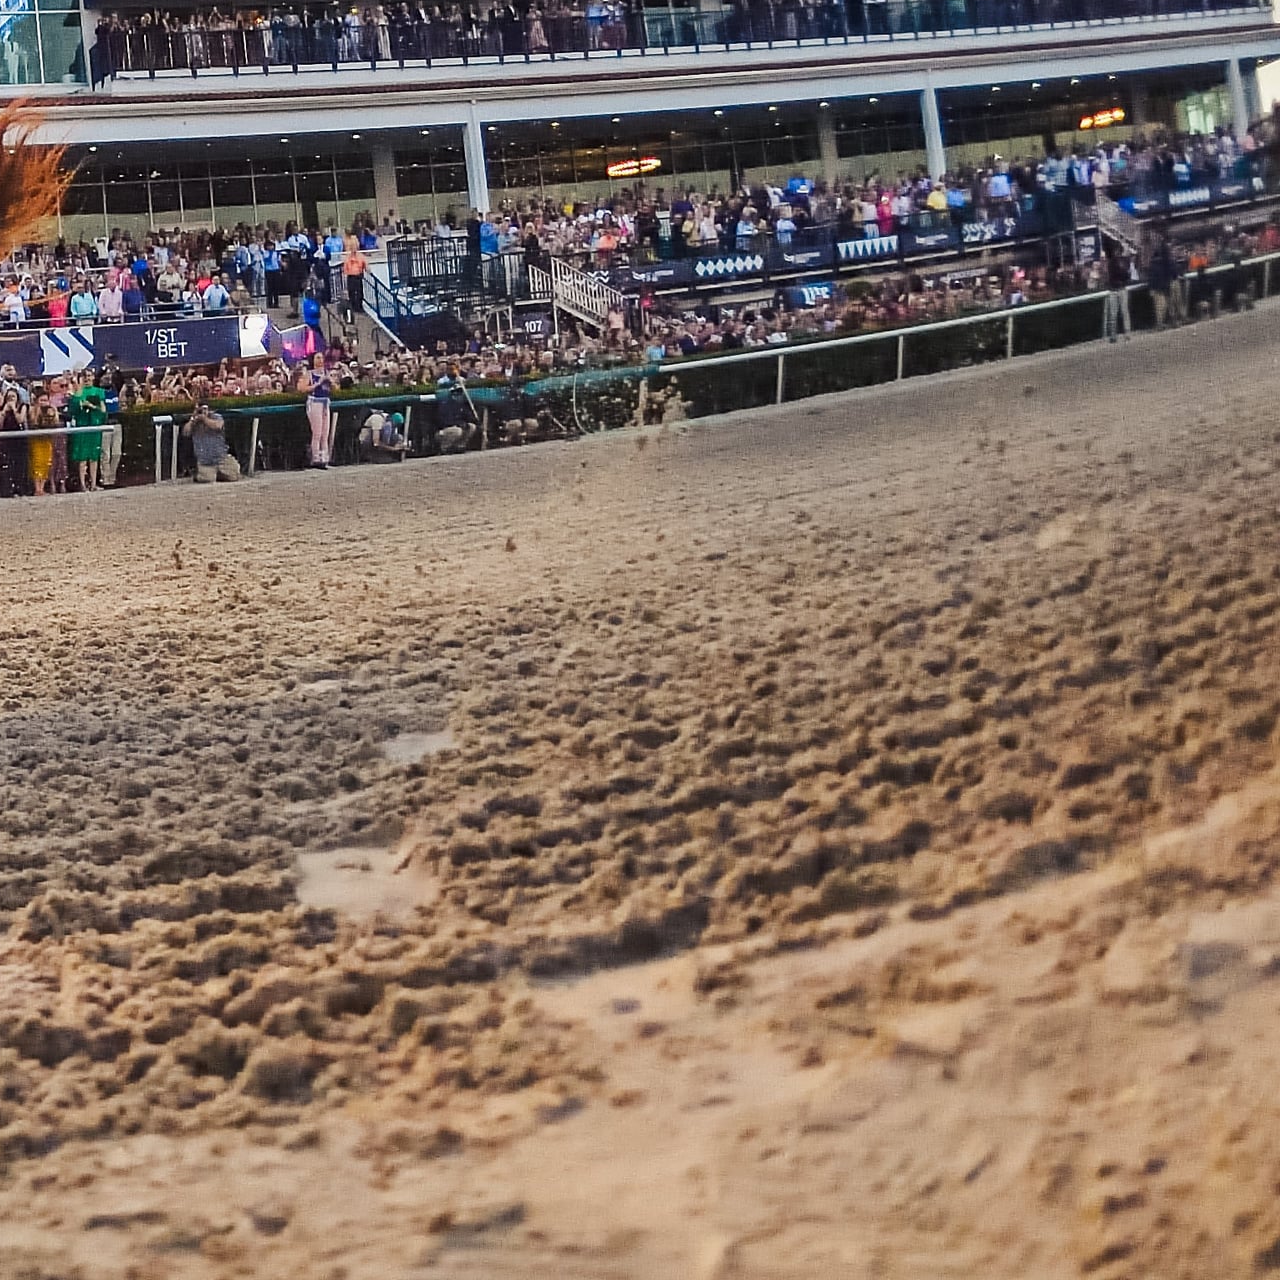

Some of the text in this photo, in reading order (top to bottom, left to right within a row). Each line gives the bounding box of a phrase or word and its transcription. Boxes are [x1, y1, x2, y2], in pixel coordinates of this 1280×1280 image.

[525, 320, 542, 333] 107
[145, 328, 178, 345] 1/ST
[158, 342, 188, 358] BET
